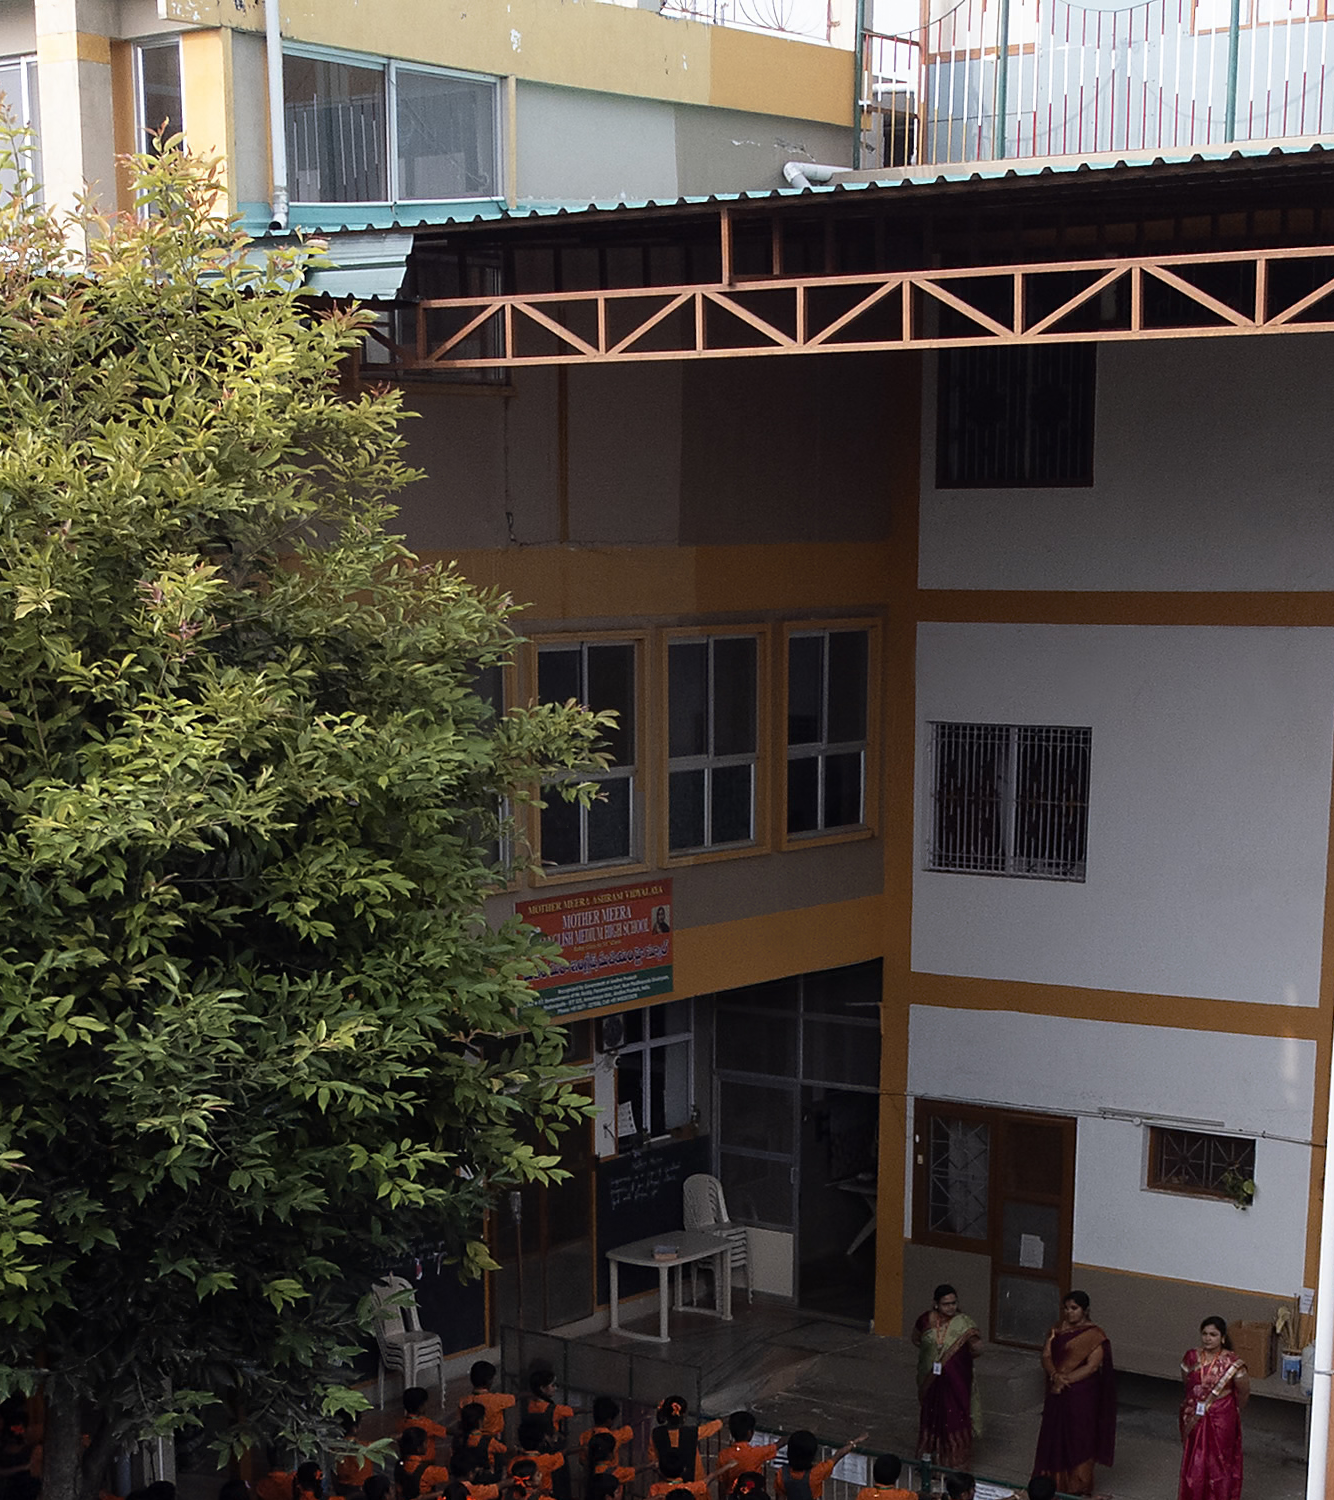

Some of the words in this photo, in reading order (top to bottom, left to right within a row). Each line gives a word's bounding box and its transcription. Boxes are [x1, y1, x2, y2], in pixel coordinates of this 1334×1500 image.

[528, 902, 562, 916] MOTHER
[562, 911, 600, 930] MOTHER
[601, 905, 632, 924] MEERA
[574, 927, 604, 945] MEDIUM
[604, 923, 623, 940] HIGH
[623, 918, 650, 935] SCHOOL
